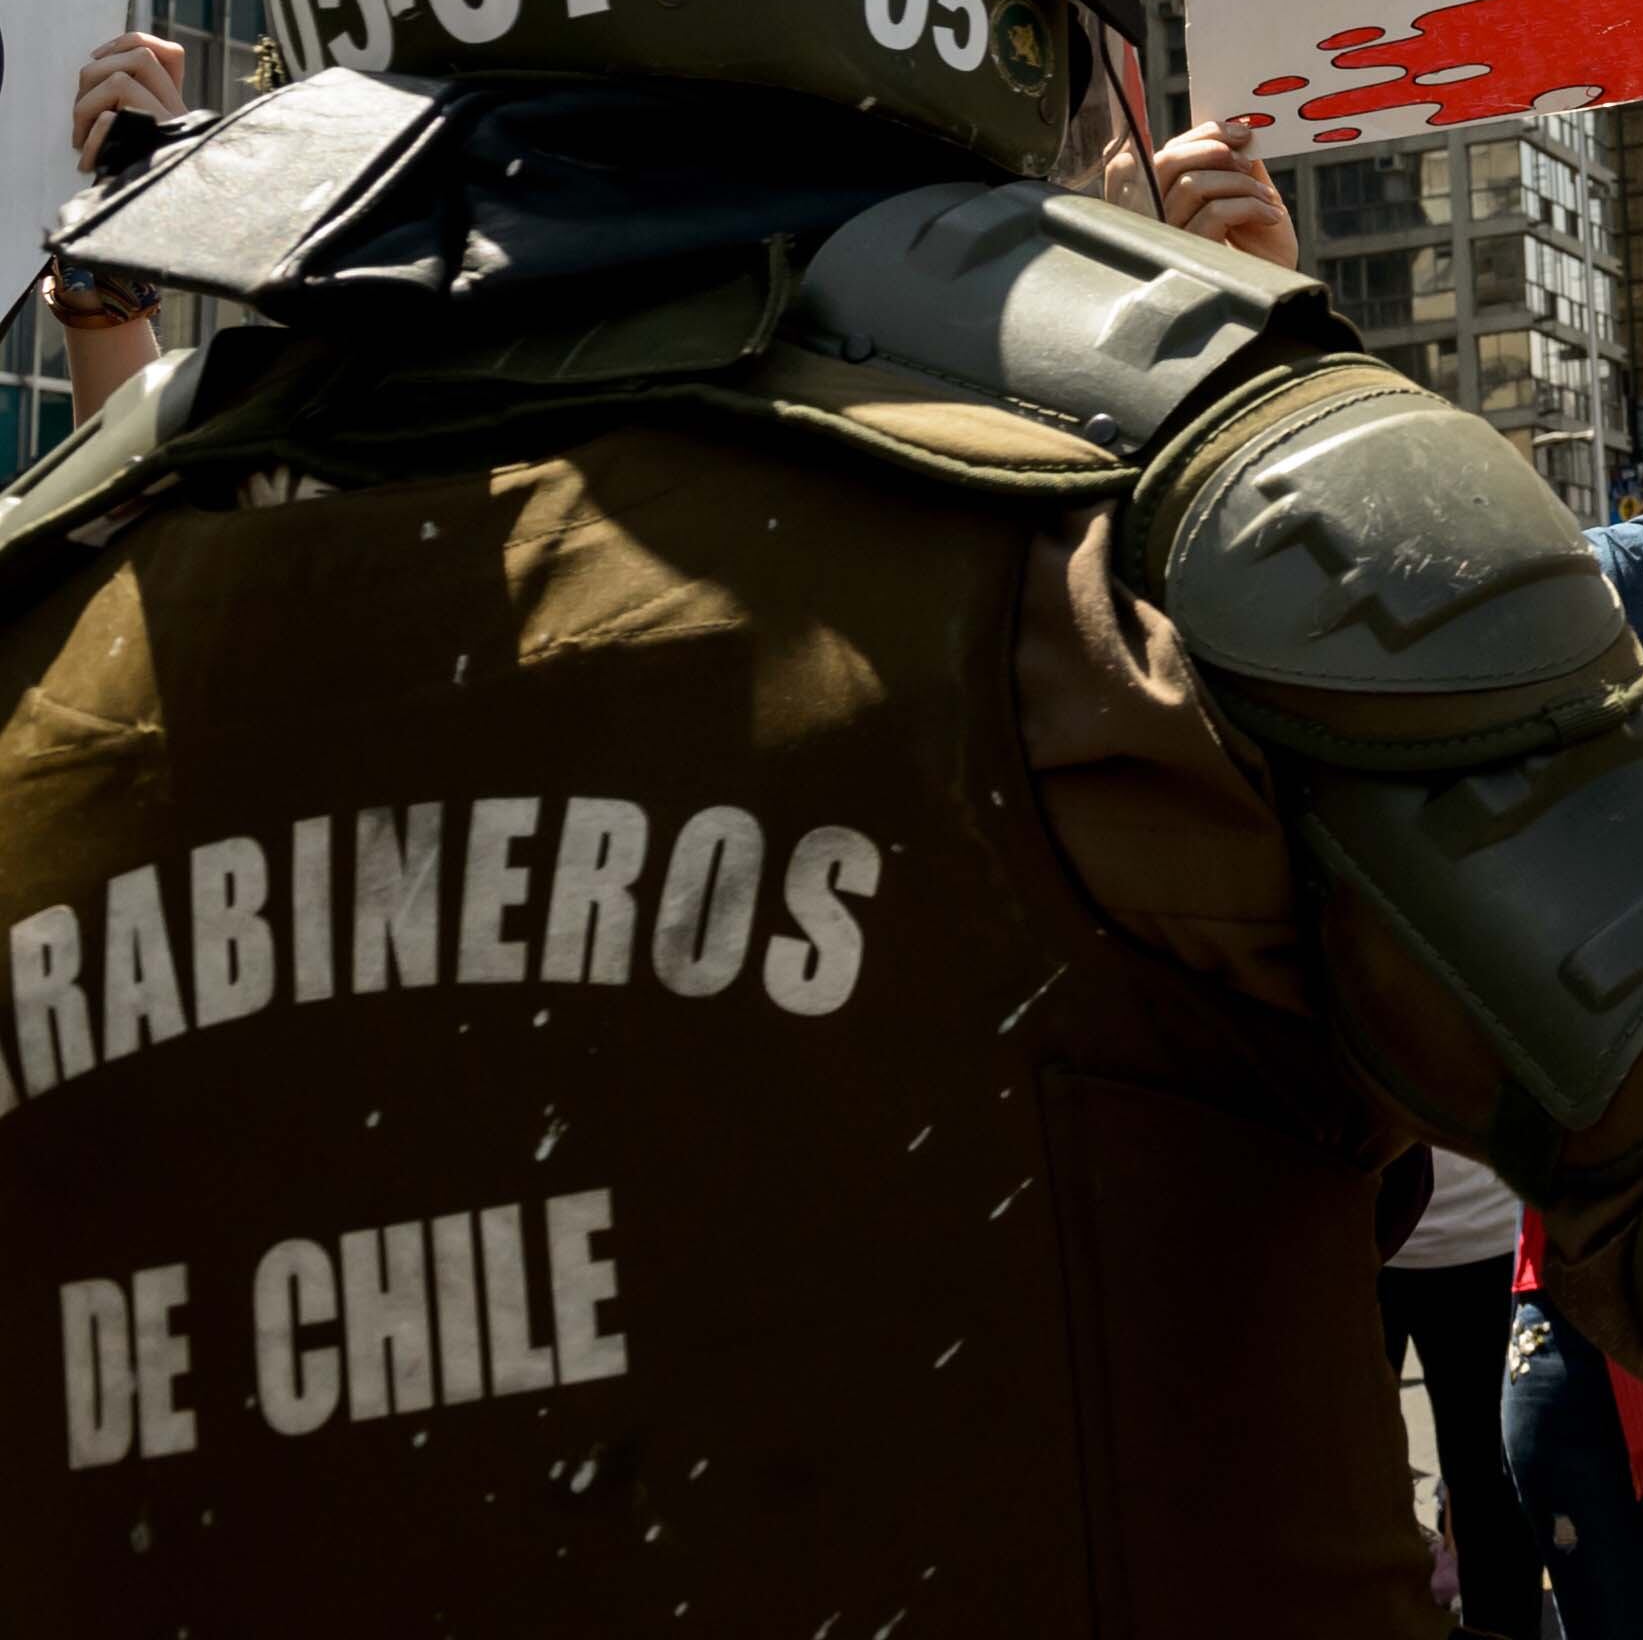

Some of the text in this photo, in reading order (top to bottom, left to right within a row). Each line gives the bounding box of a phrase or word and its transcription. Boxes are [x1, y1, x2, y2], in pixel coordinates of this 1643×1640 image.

[0, 796, 882, 1118] RABINEROS
[60, 1187, 629, 1471] DE CHILE
